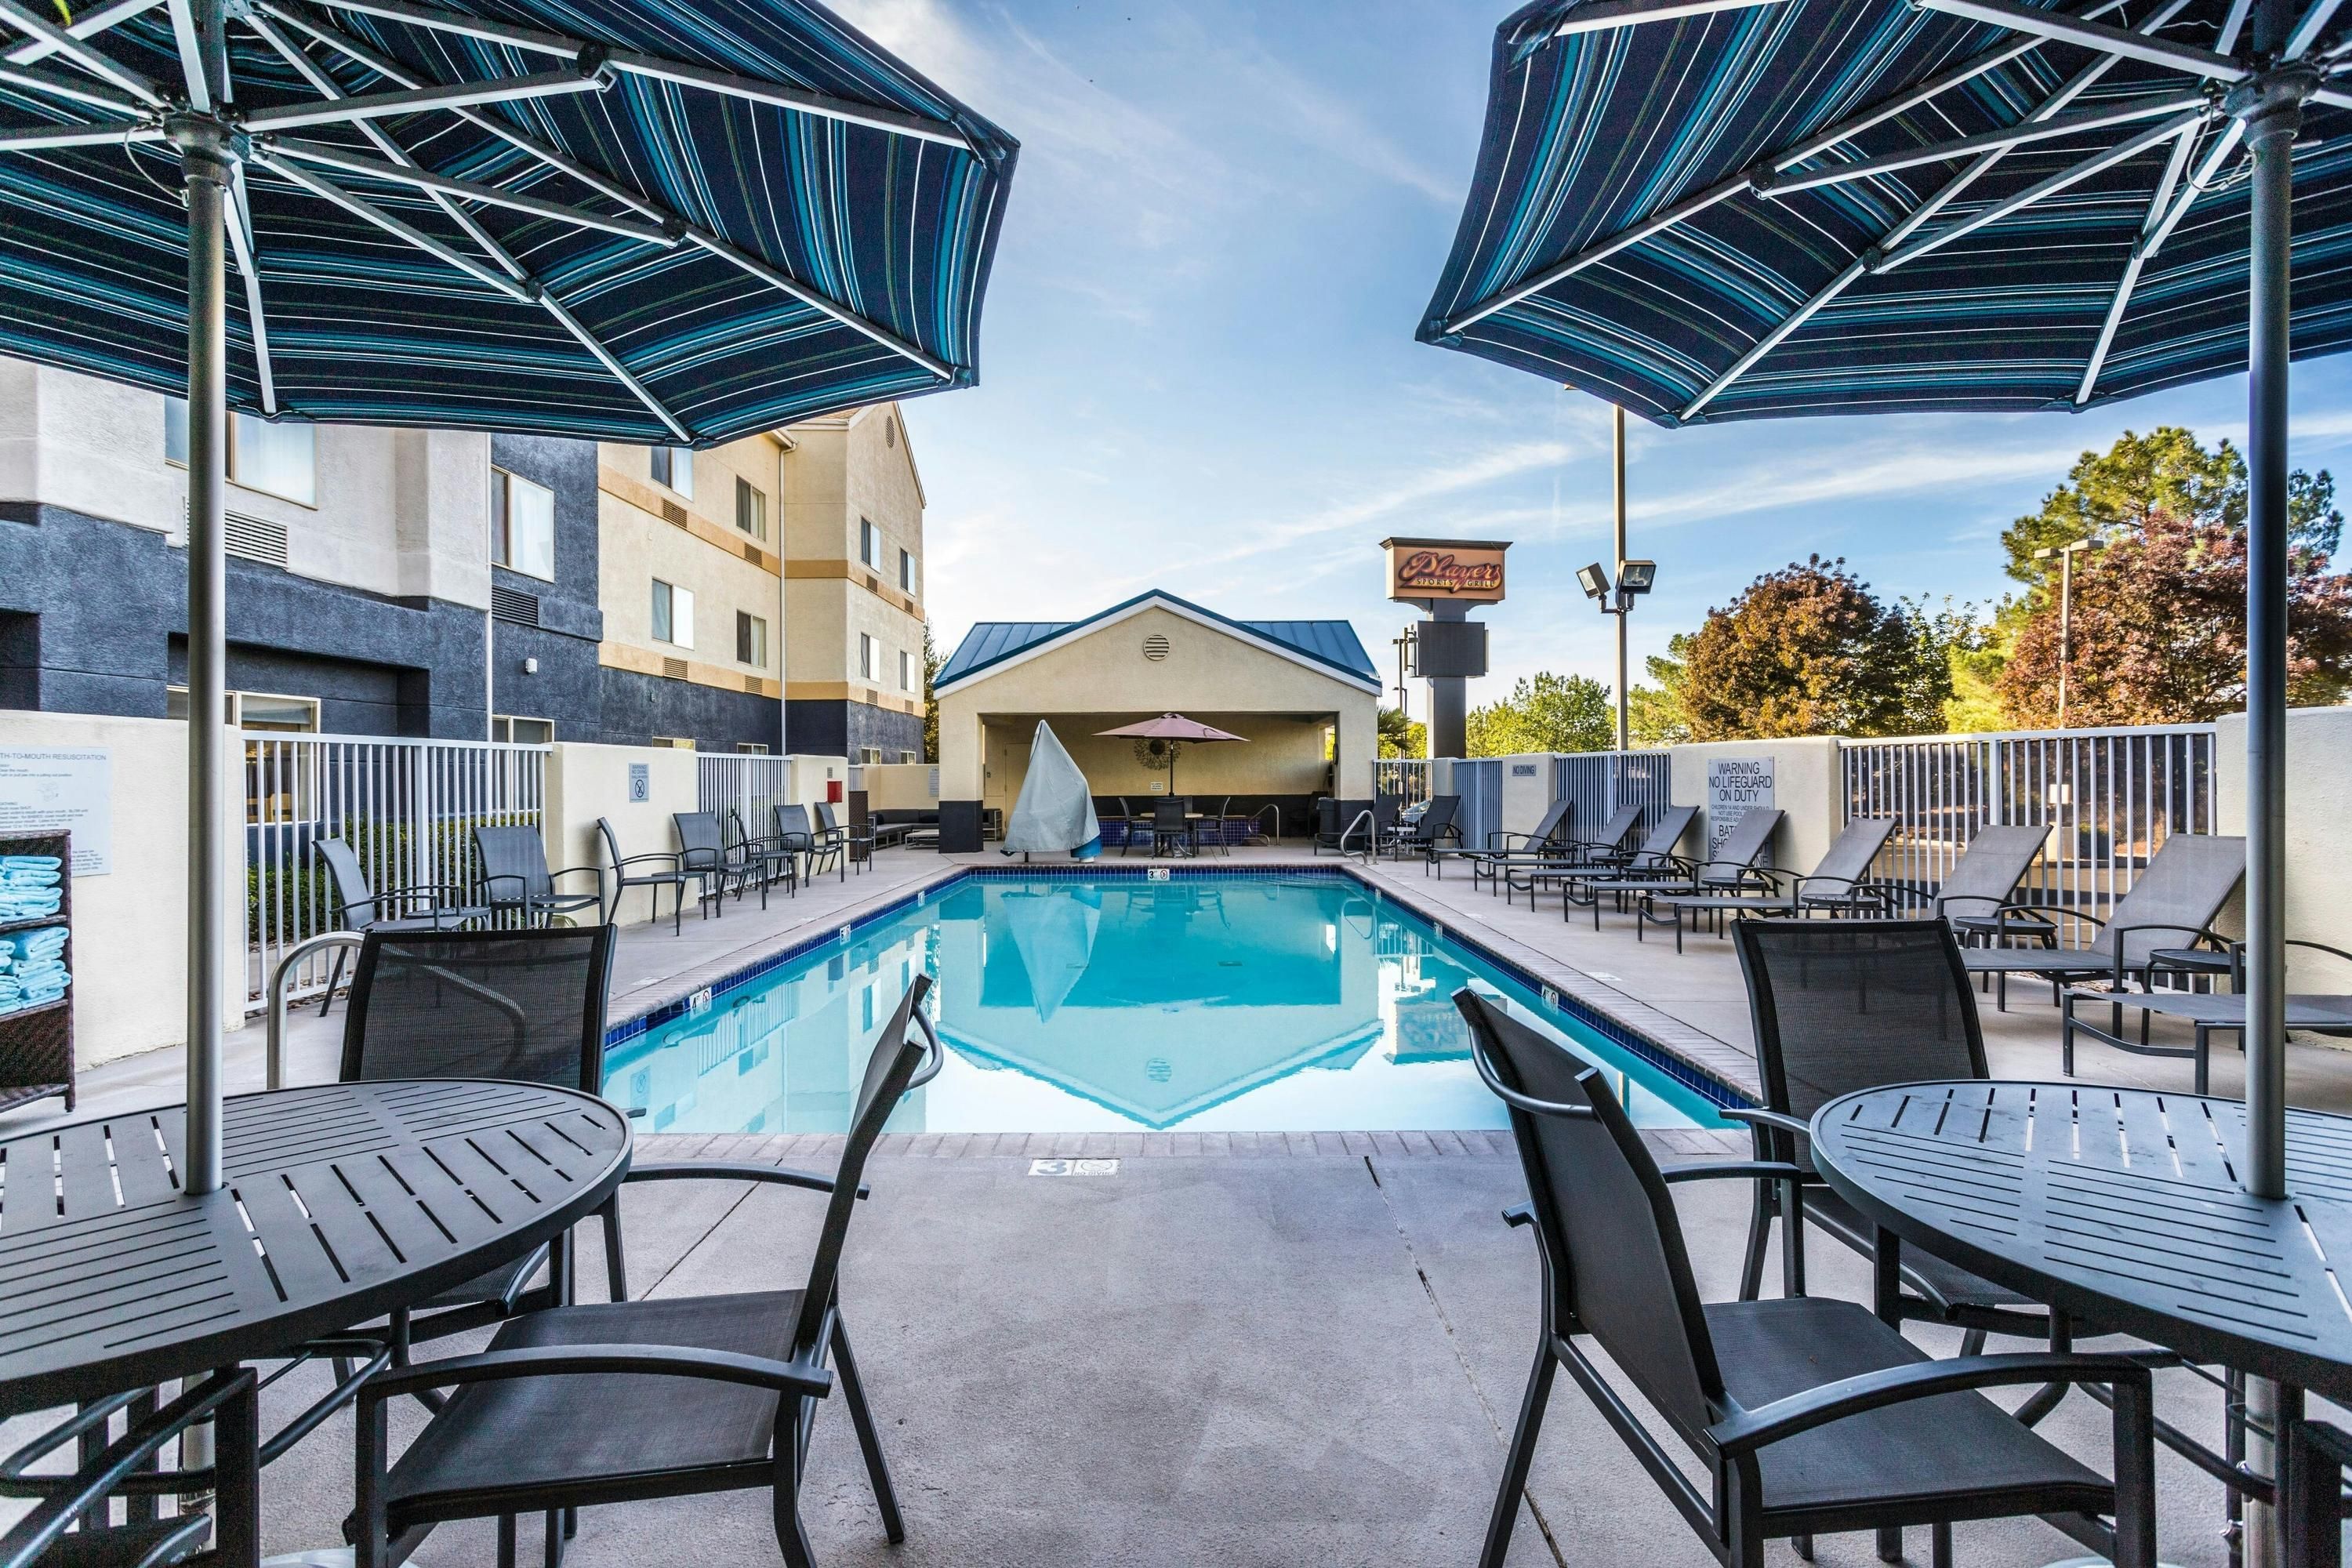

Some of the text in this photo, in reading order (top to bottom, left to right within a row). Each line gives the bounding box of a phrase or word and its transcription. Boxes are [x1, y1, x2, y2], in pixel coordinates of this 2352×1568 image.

[1399, 551, 1503, 593] Players
[1512, 765, 1534, 775] NO DIVING
[1718, 761, 1760, 775] WARNING
[1708, 775, 1773, 789] NO LIFEGUARD
[1719, 789, 1759, 802] ON DUTY
[1036, 1160, 1067, 1174] 3
